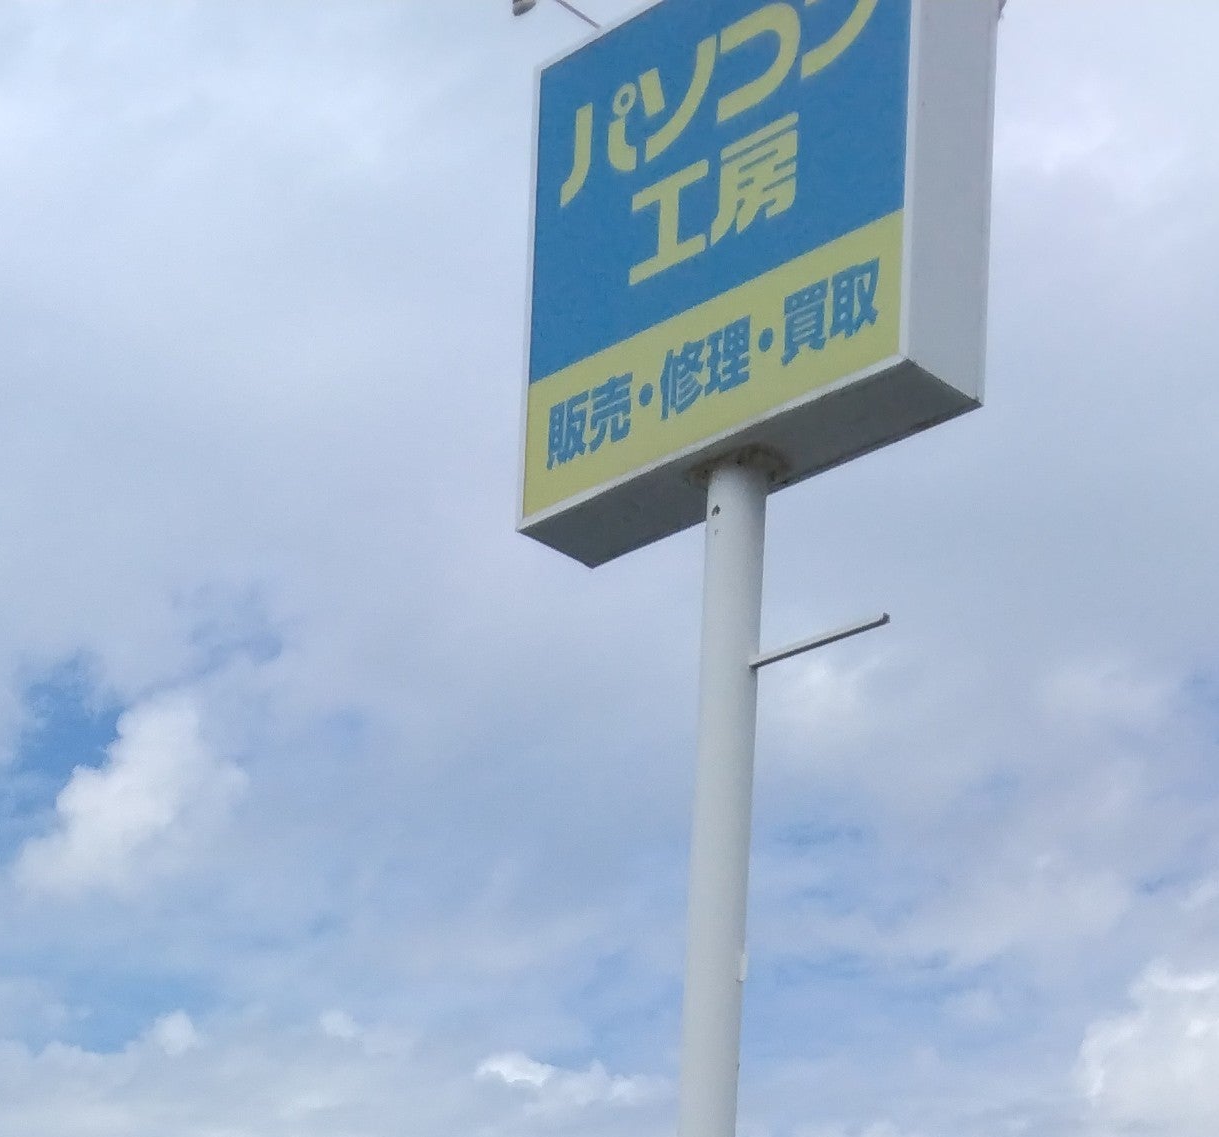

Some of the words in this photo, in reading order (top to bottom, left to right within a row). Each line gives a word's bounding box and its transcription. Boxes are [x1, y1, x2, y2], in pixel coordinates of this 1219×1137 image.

[628, 111, 799, 286] 工房
[547, 257, 880, 470] 販売・修理・買取
